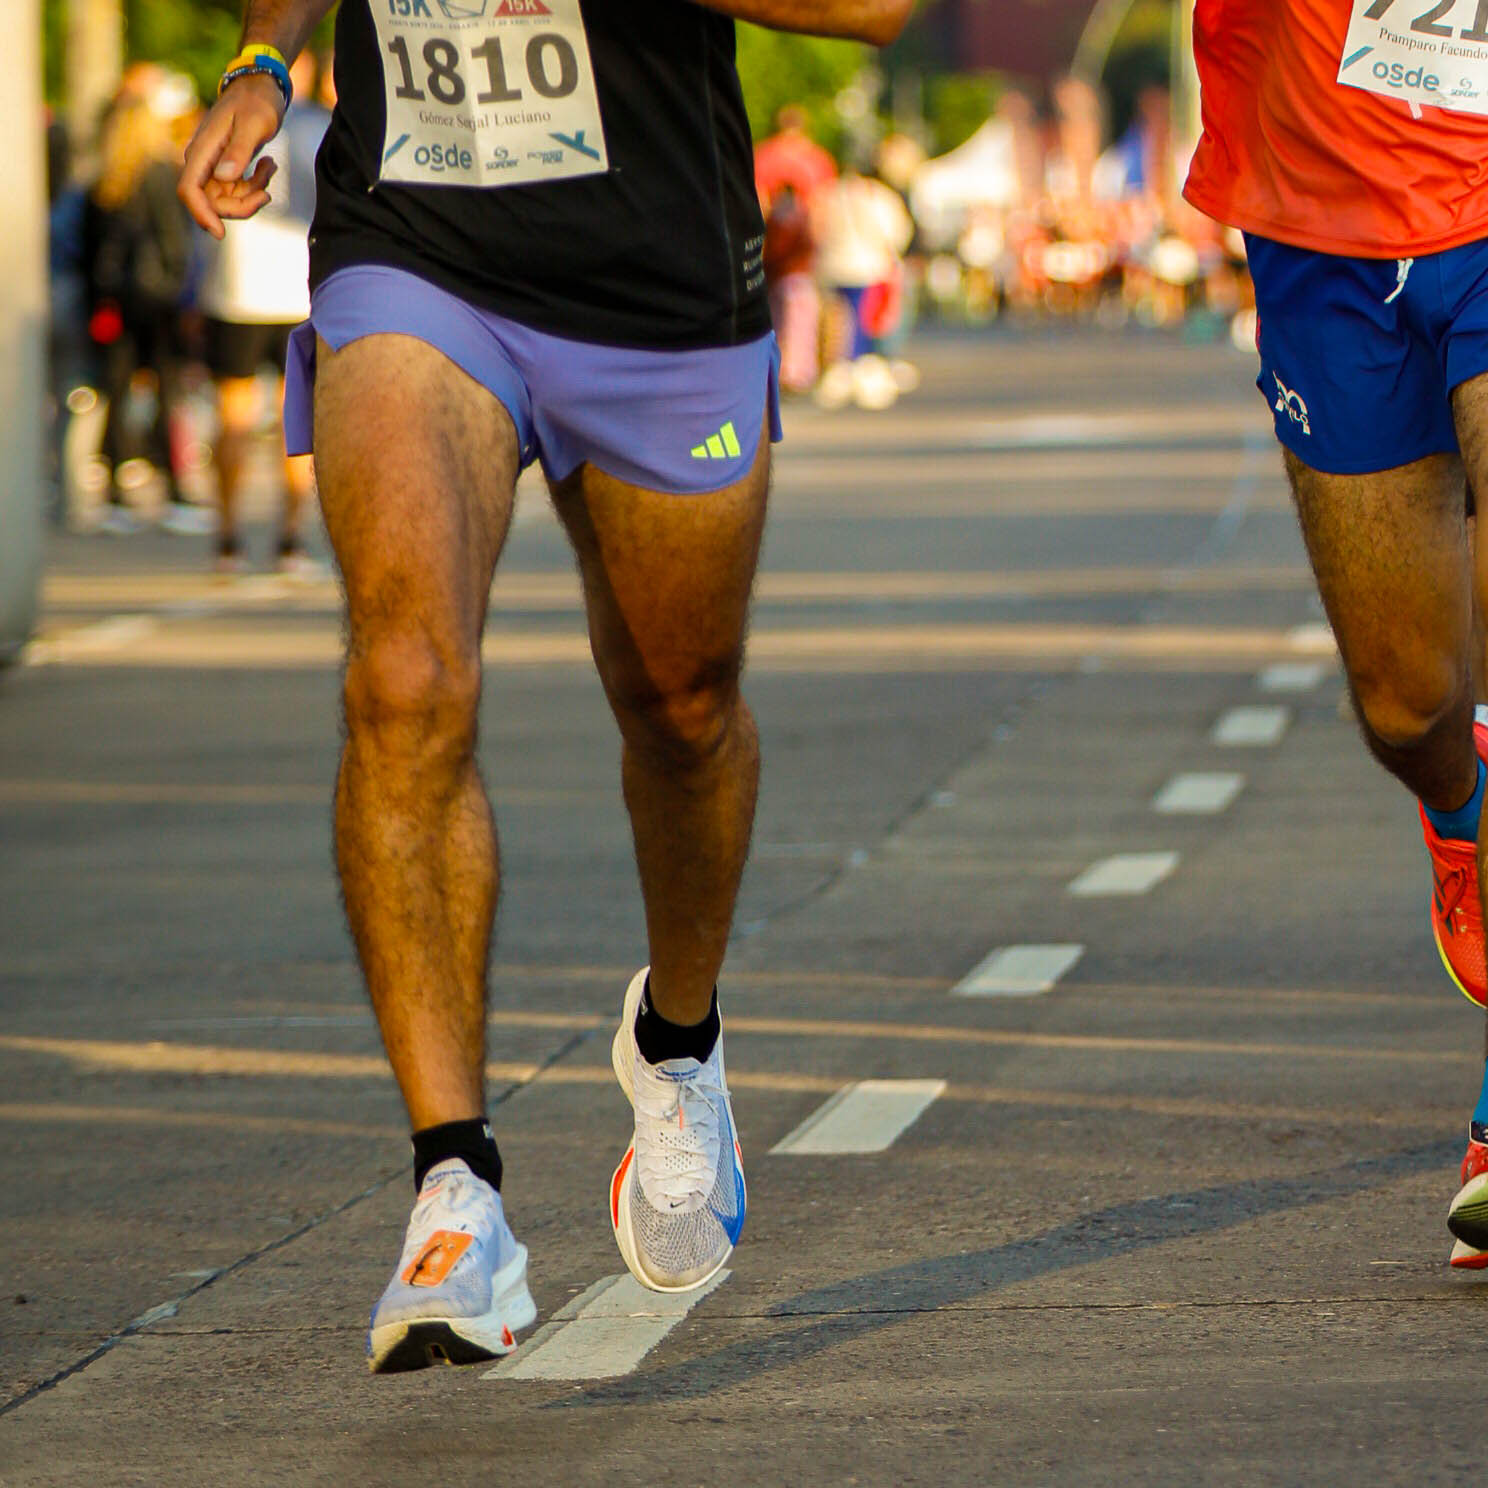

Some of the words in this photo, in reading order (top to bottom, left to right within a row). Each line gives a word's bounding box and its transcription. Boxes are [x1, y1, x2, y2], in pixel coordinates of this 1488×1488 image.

[1379, 27, 1437, 52] Pramparo
[1440, 42, 1488, 61] Facundo
[388, 32, 579, 106] 1810
[1372, 61, 1440, 92] osde
[494, 111, 551, 126] Luciano
[414, 144, 472, 171] osde
